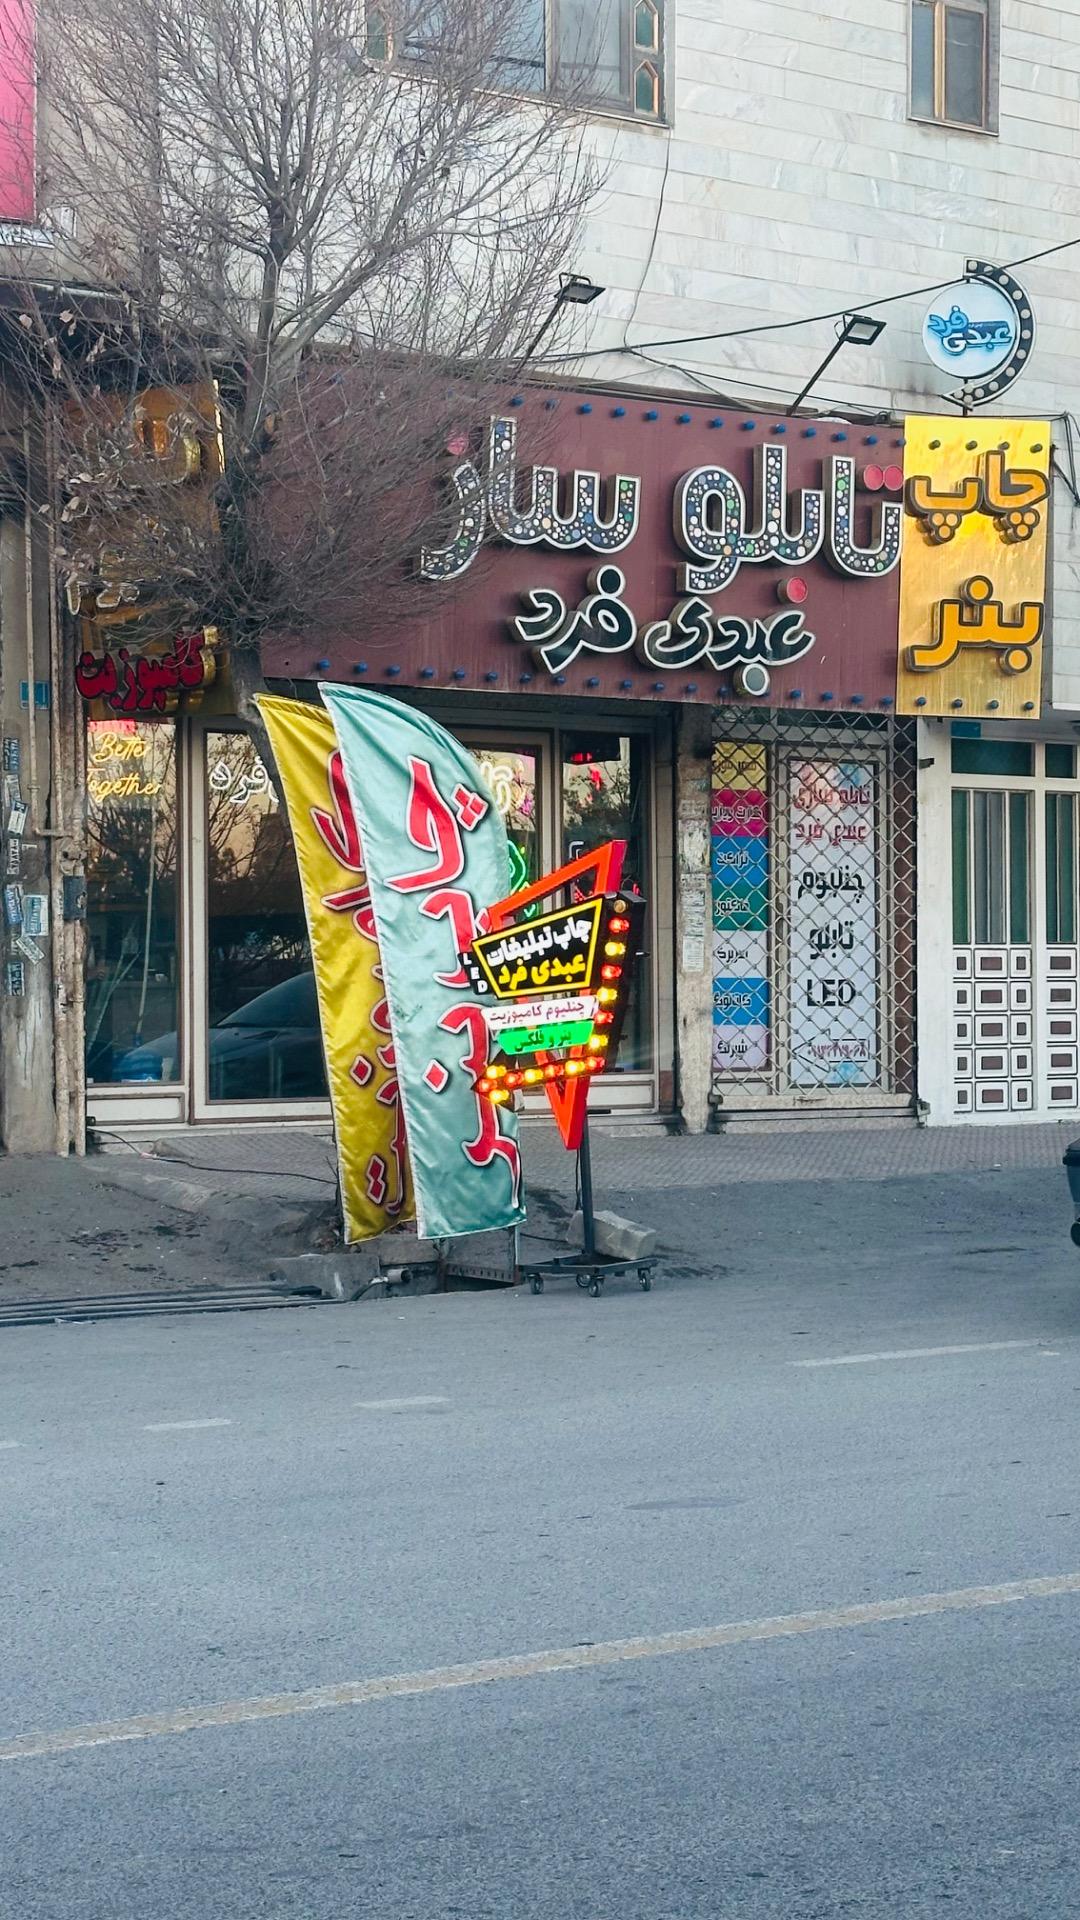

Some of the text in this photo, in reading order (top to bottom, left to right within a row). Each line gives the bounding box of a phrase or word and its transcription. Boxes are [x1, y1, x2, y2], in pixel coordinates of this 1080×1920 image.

[928, 305, 1013, 356] عبدی فرد
[420, 415, 904, 604] تابلو ساز
[905, 451, 1050, 545] چاپ
[509, 564, 816, 697] عبدی فرد
[905, 575, 1045, 674] بنر
[93, 731, 150, 762] Better
[86, 768, 162, 803] Together
[486, 916, 593, 968] چاپ تبلیغات
[498, 954, 586, 991] عبدی فرد
[806, 979, 857, 1007] LED
